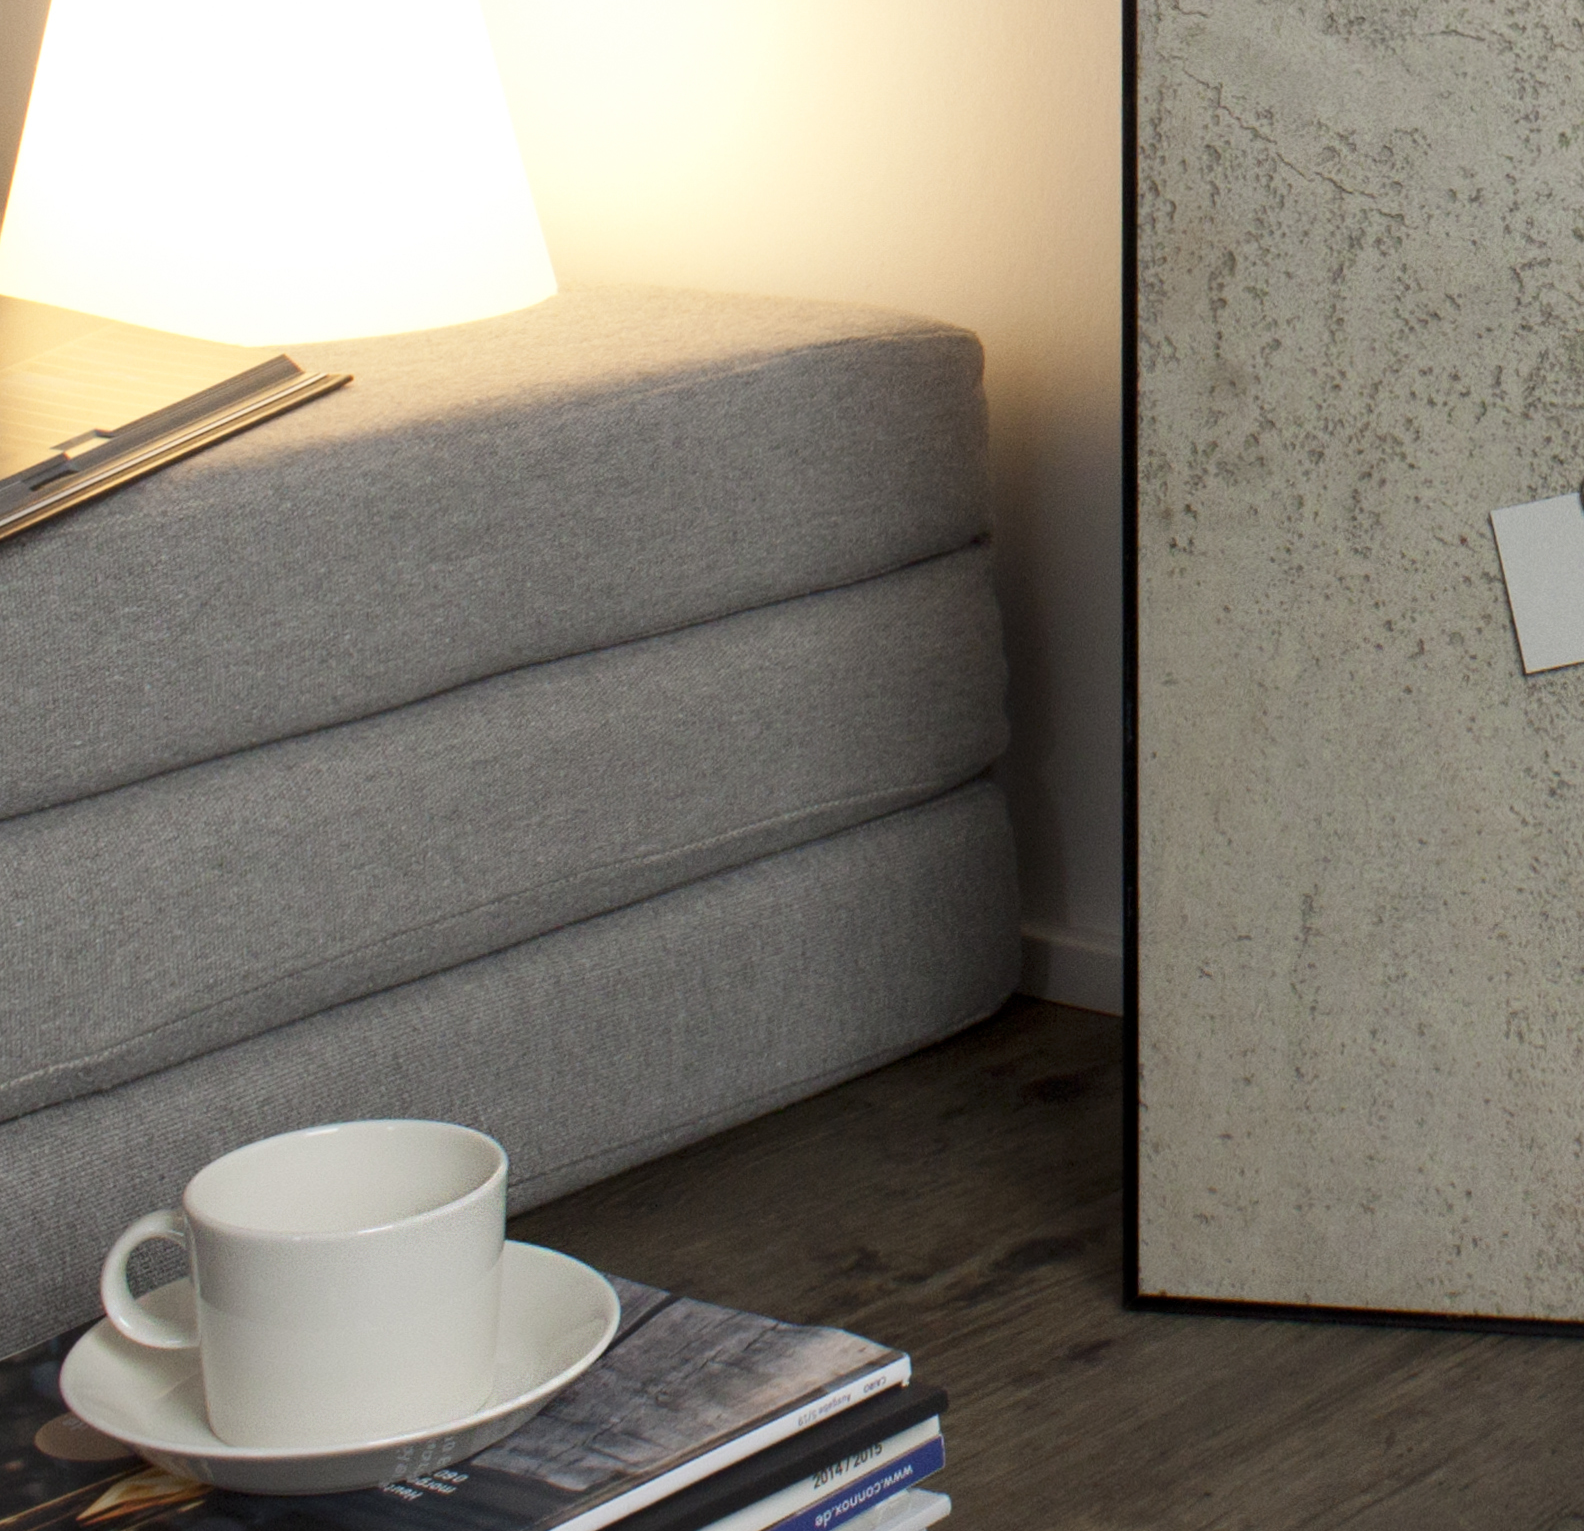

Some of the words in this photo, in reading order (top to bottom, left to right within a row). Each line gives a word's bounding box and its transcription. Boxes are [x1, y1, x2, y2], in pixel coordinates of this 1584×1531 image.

[818, 1392, 852, 1415] Ausgabe
[812, 1461, 843, 1490] 2014
[853, 1442, 884, 1468] 2015
[814, 1463, 914, 1528] www.connox.de
